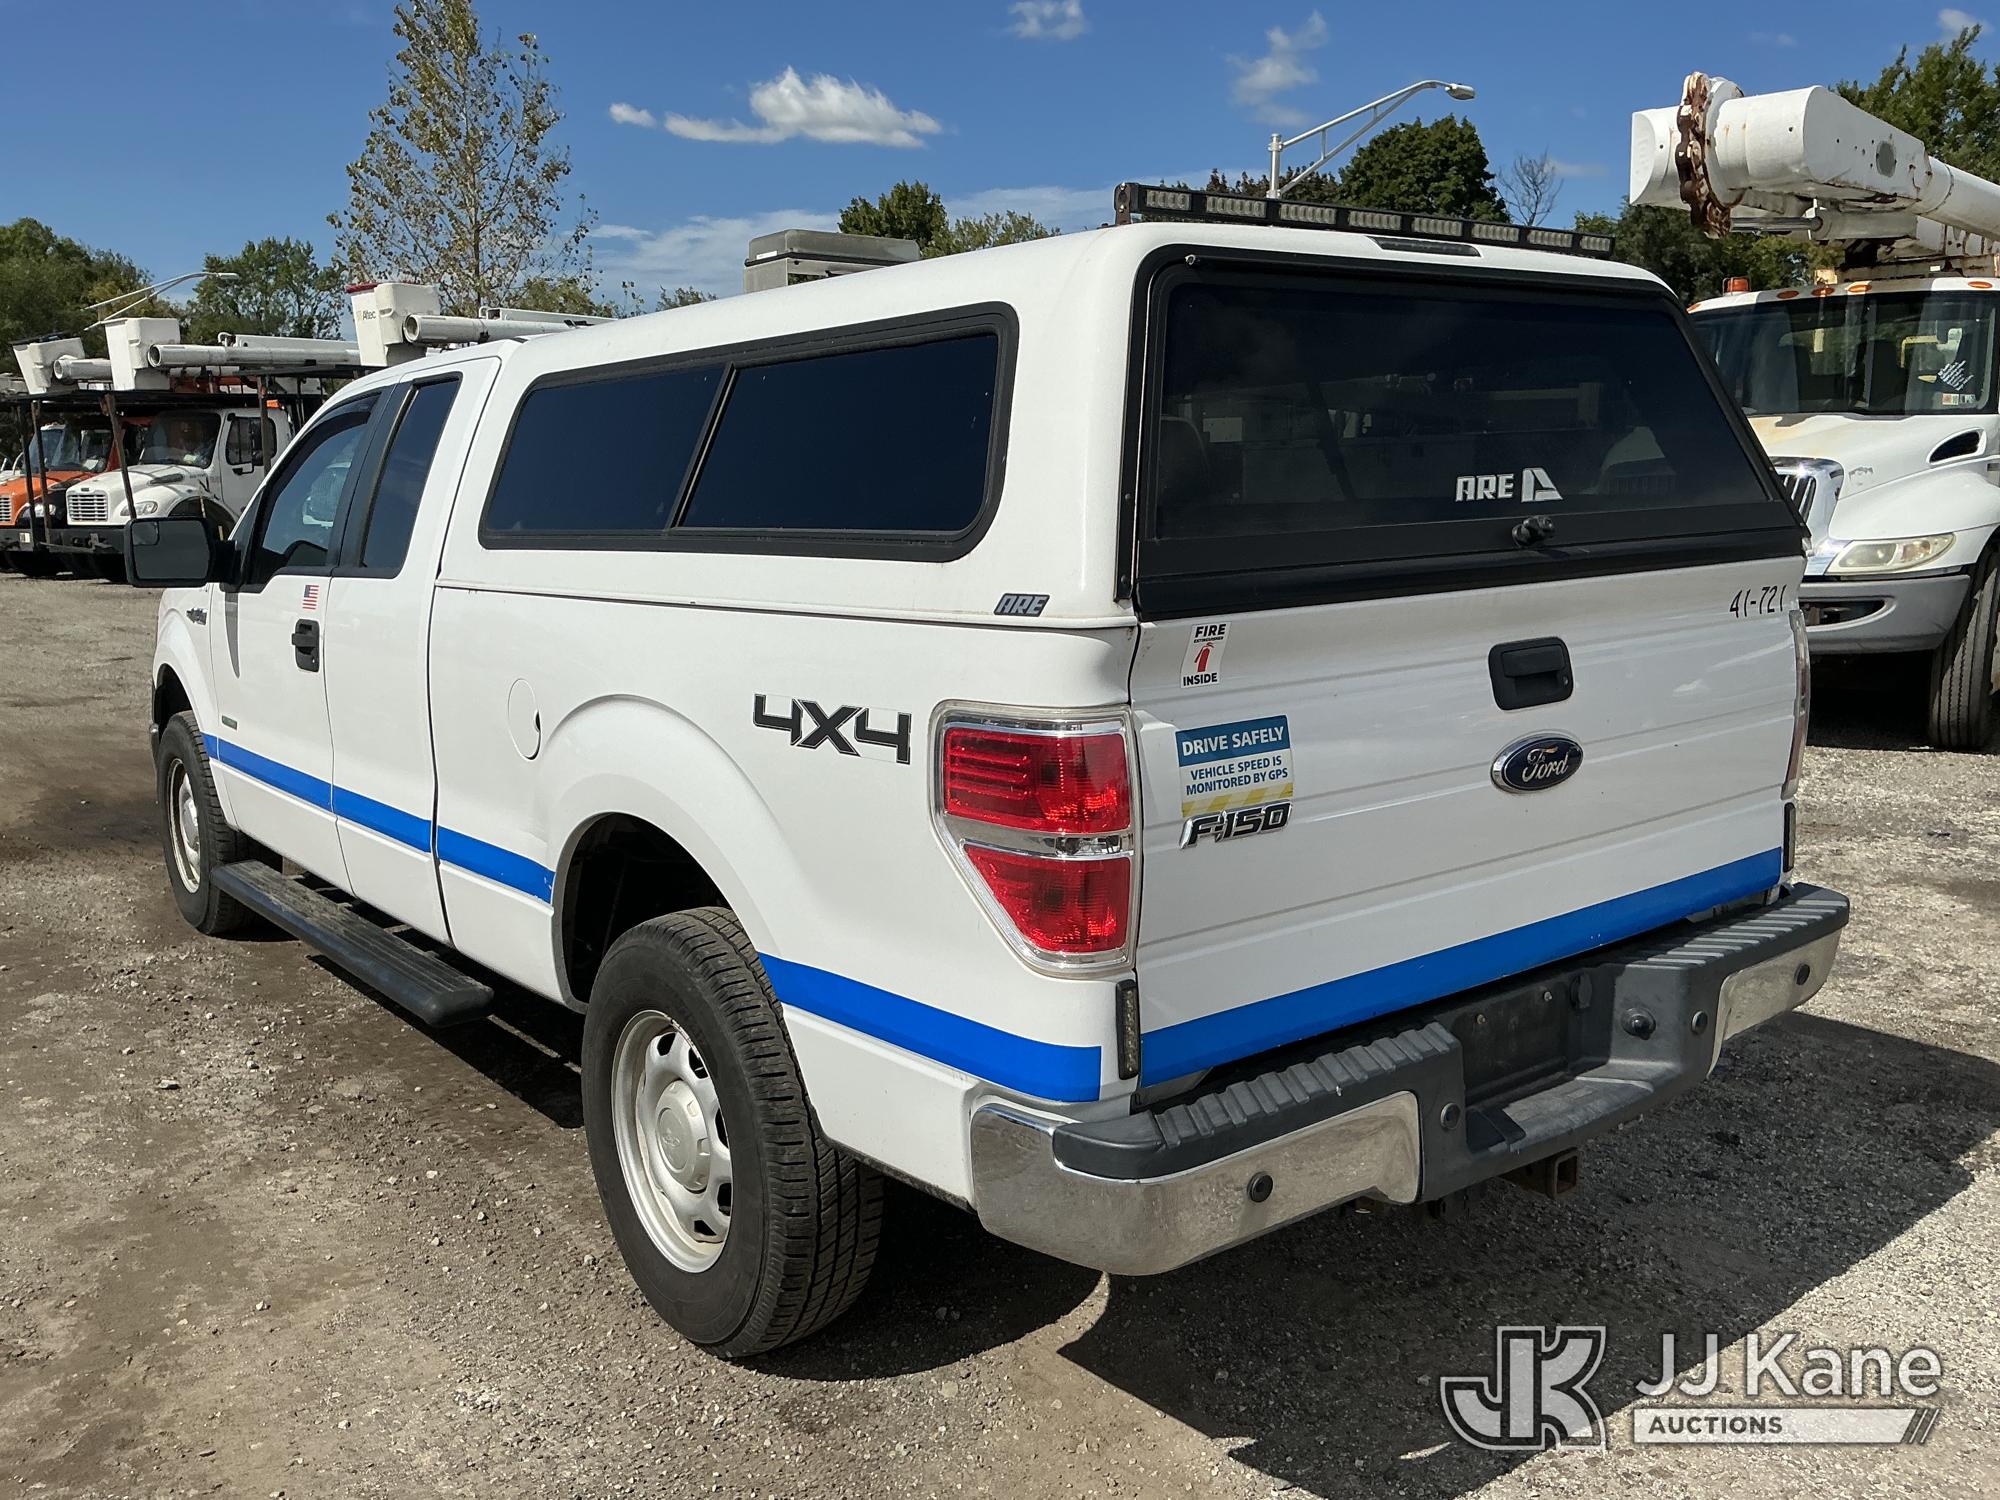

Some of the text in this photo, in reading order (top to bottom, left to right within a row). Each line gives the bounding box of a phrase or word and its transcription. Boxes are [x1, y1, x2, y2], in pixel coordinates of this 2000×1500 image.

[1455, 474, 1514, 502] ARE
[995, 595, 1048, 615] ARE
[1729, 584, 1787, 618] 41-721
[1195, 624, 1226, 638] FIRE
[1183, 673, 1217, 686] INSIDE
[1182, 726, 1284, 756] DRIVE SAFELY
[1190, 755, 1282, 780] VEHICLE SPEED IS
[1521, 746, 1569, 782] Ford
[1186, 768, 1288, 796] MONITORED BY GPS
[1179, 800, 1293, 850] F-150
